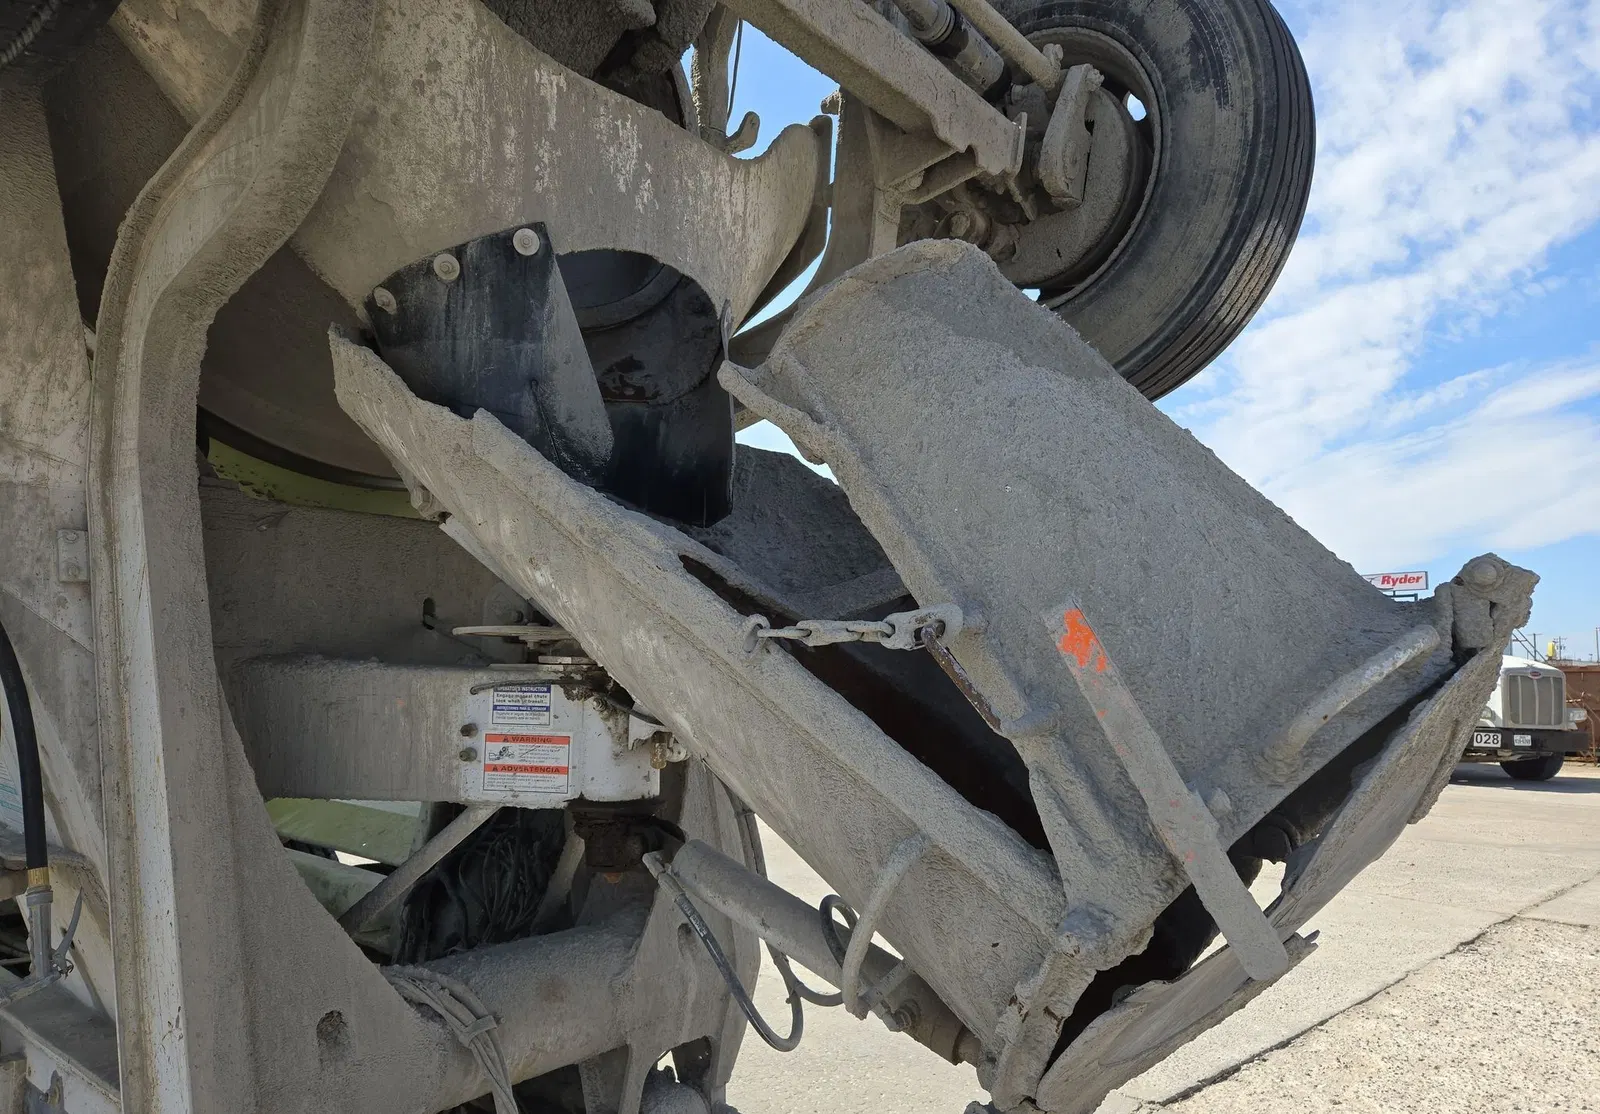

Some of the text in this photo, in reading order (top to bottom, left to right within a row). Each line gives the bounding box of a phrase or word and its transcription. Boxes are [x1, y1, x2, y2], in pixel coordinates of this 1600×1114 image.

[1381, 574, 1423, 587] Ryder
[511, 736, 552, 744] WARNING
[1475, 733, 1500, 745] 028
[501, 765, 560, 774] ADVERTENCIA
